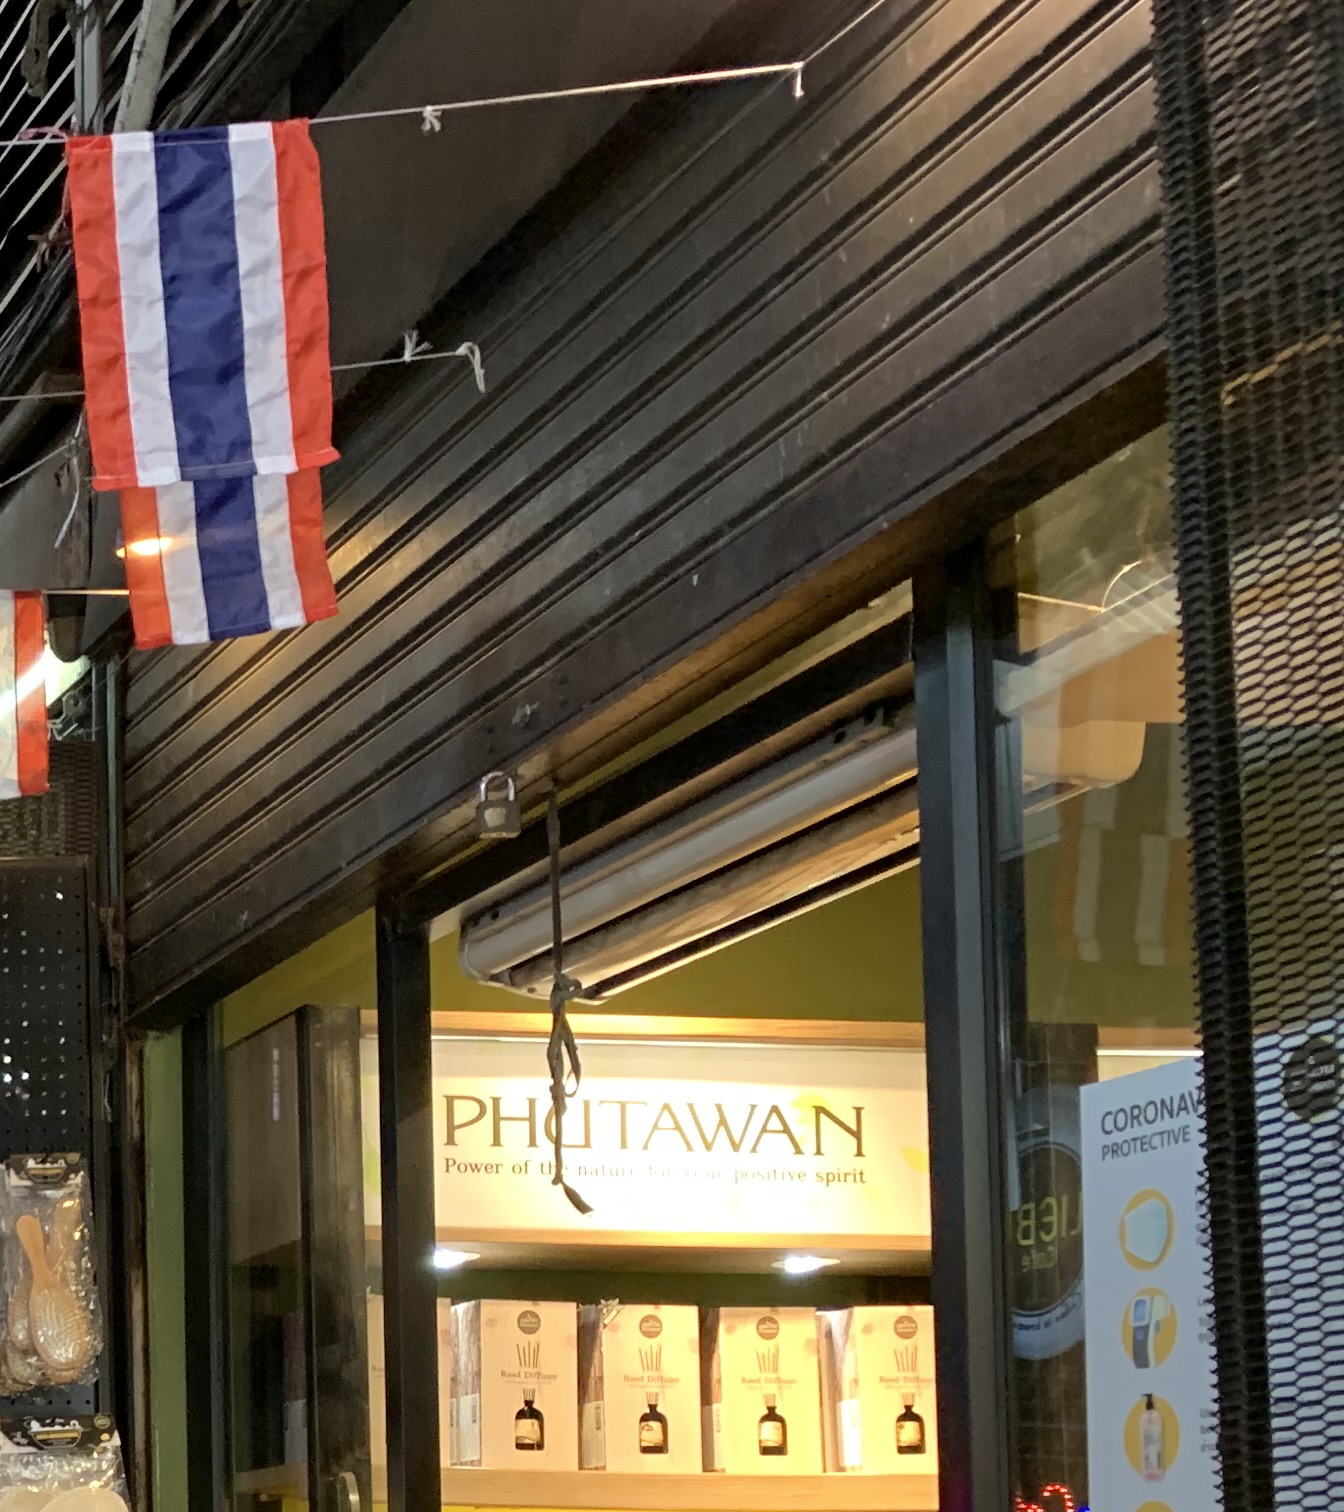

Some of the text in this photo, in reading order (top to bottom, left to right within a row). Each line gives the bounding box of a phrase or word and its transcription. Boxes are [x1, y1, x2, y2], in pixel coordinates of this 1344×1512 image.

[442, 1094, 866, 1157] PHUTAWAN
[1101, 1089, 1202, 1136] CORONAV
[1101, 1124, 1192, 1162] PROTECTIVE
[444, 1157, 503, 1175] Power
[512, 1159, 532, 1175] of
[734, 1168, 807, 1185] positive
[816, 1168, 867, 1187] spirit
[524, 1370, 558, 1381] Diffuser
